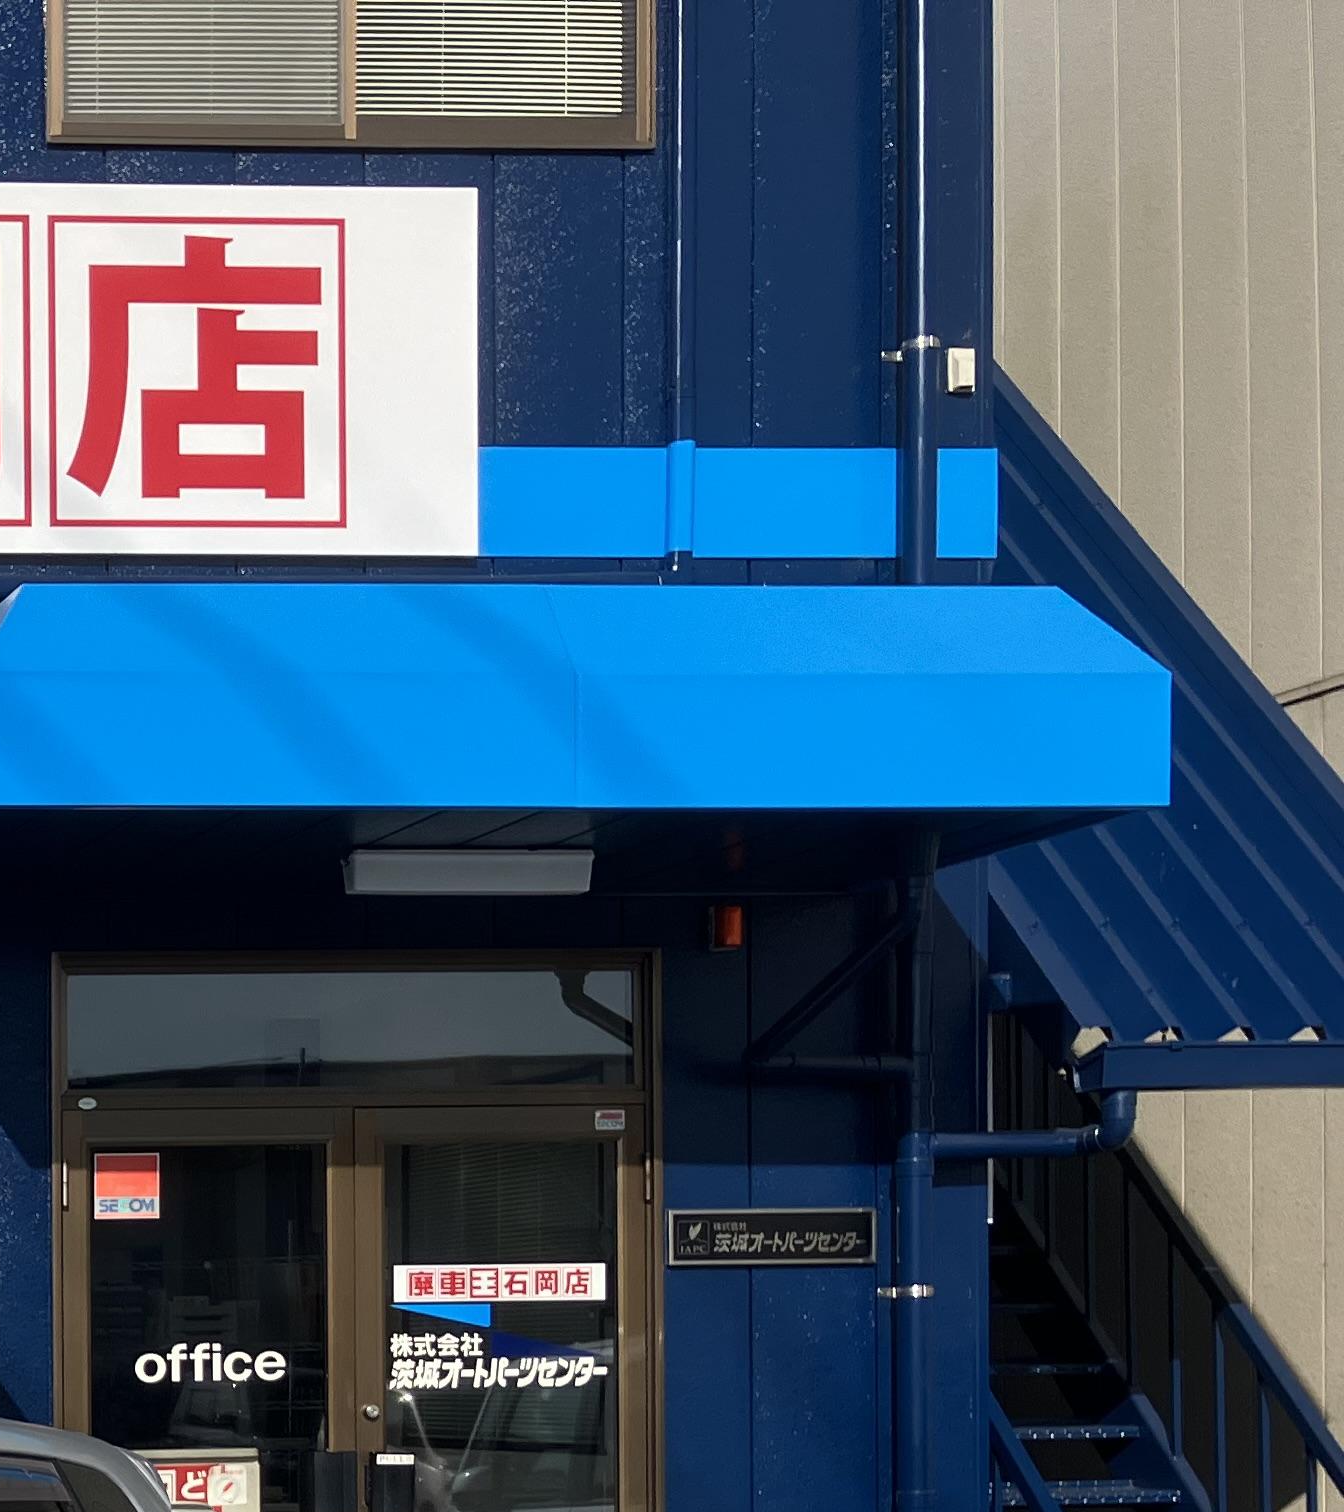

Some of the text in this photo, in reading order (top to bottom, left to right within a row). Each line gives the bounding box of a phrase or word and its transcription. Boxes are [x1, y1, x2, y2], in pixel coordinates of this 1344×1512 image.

[99, 1198, 155, 1213] SECOM
[408, 1268, 590, 1298] 廃車王石岡店
[390, 1332, 483, 1357] 株式会社
[134, 1342, 287, 1384] office
[389, 1356, 608, 1389] 茨城オートパーツセンター
